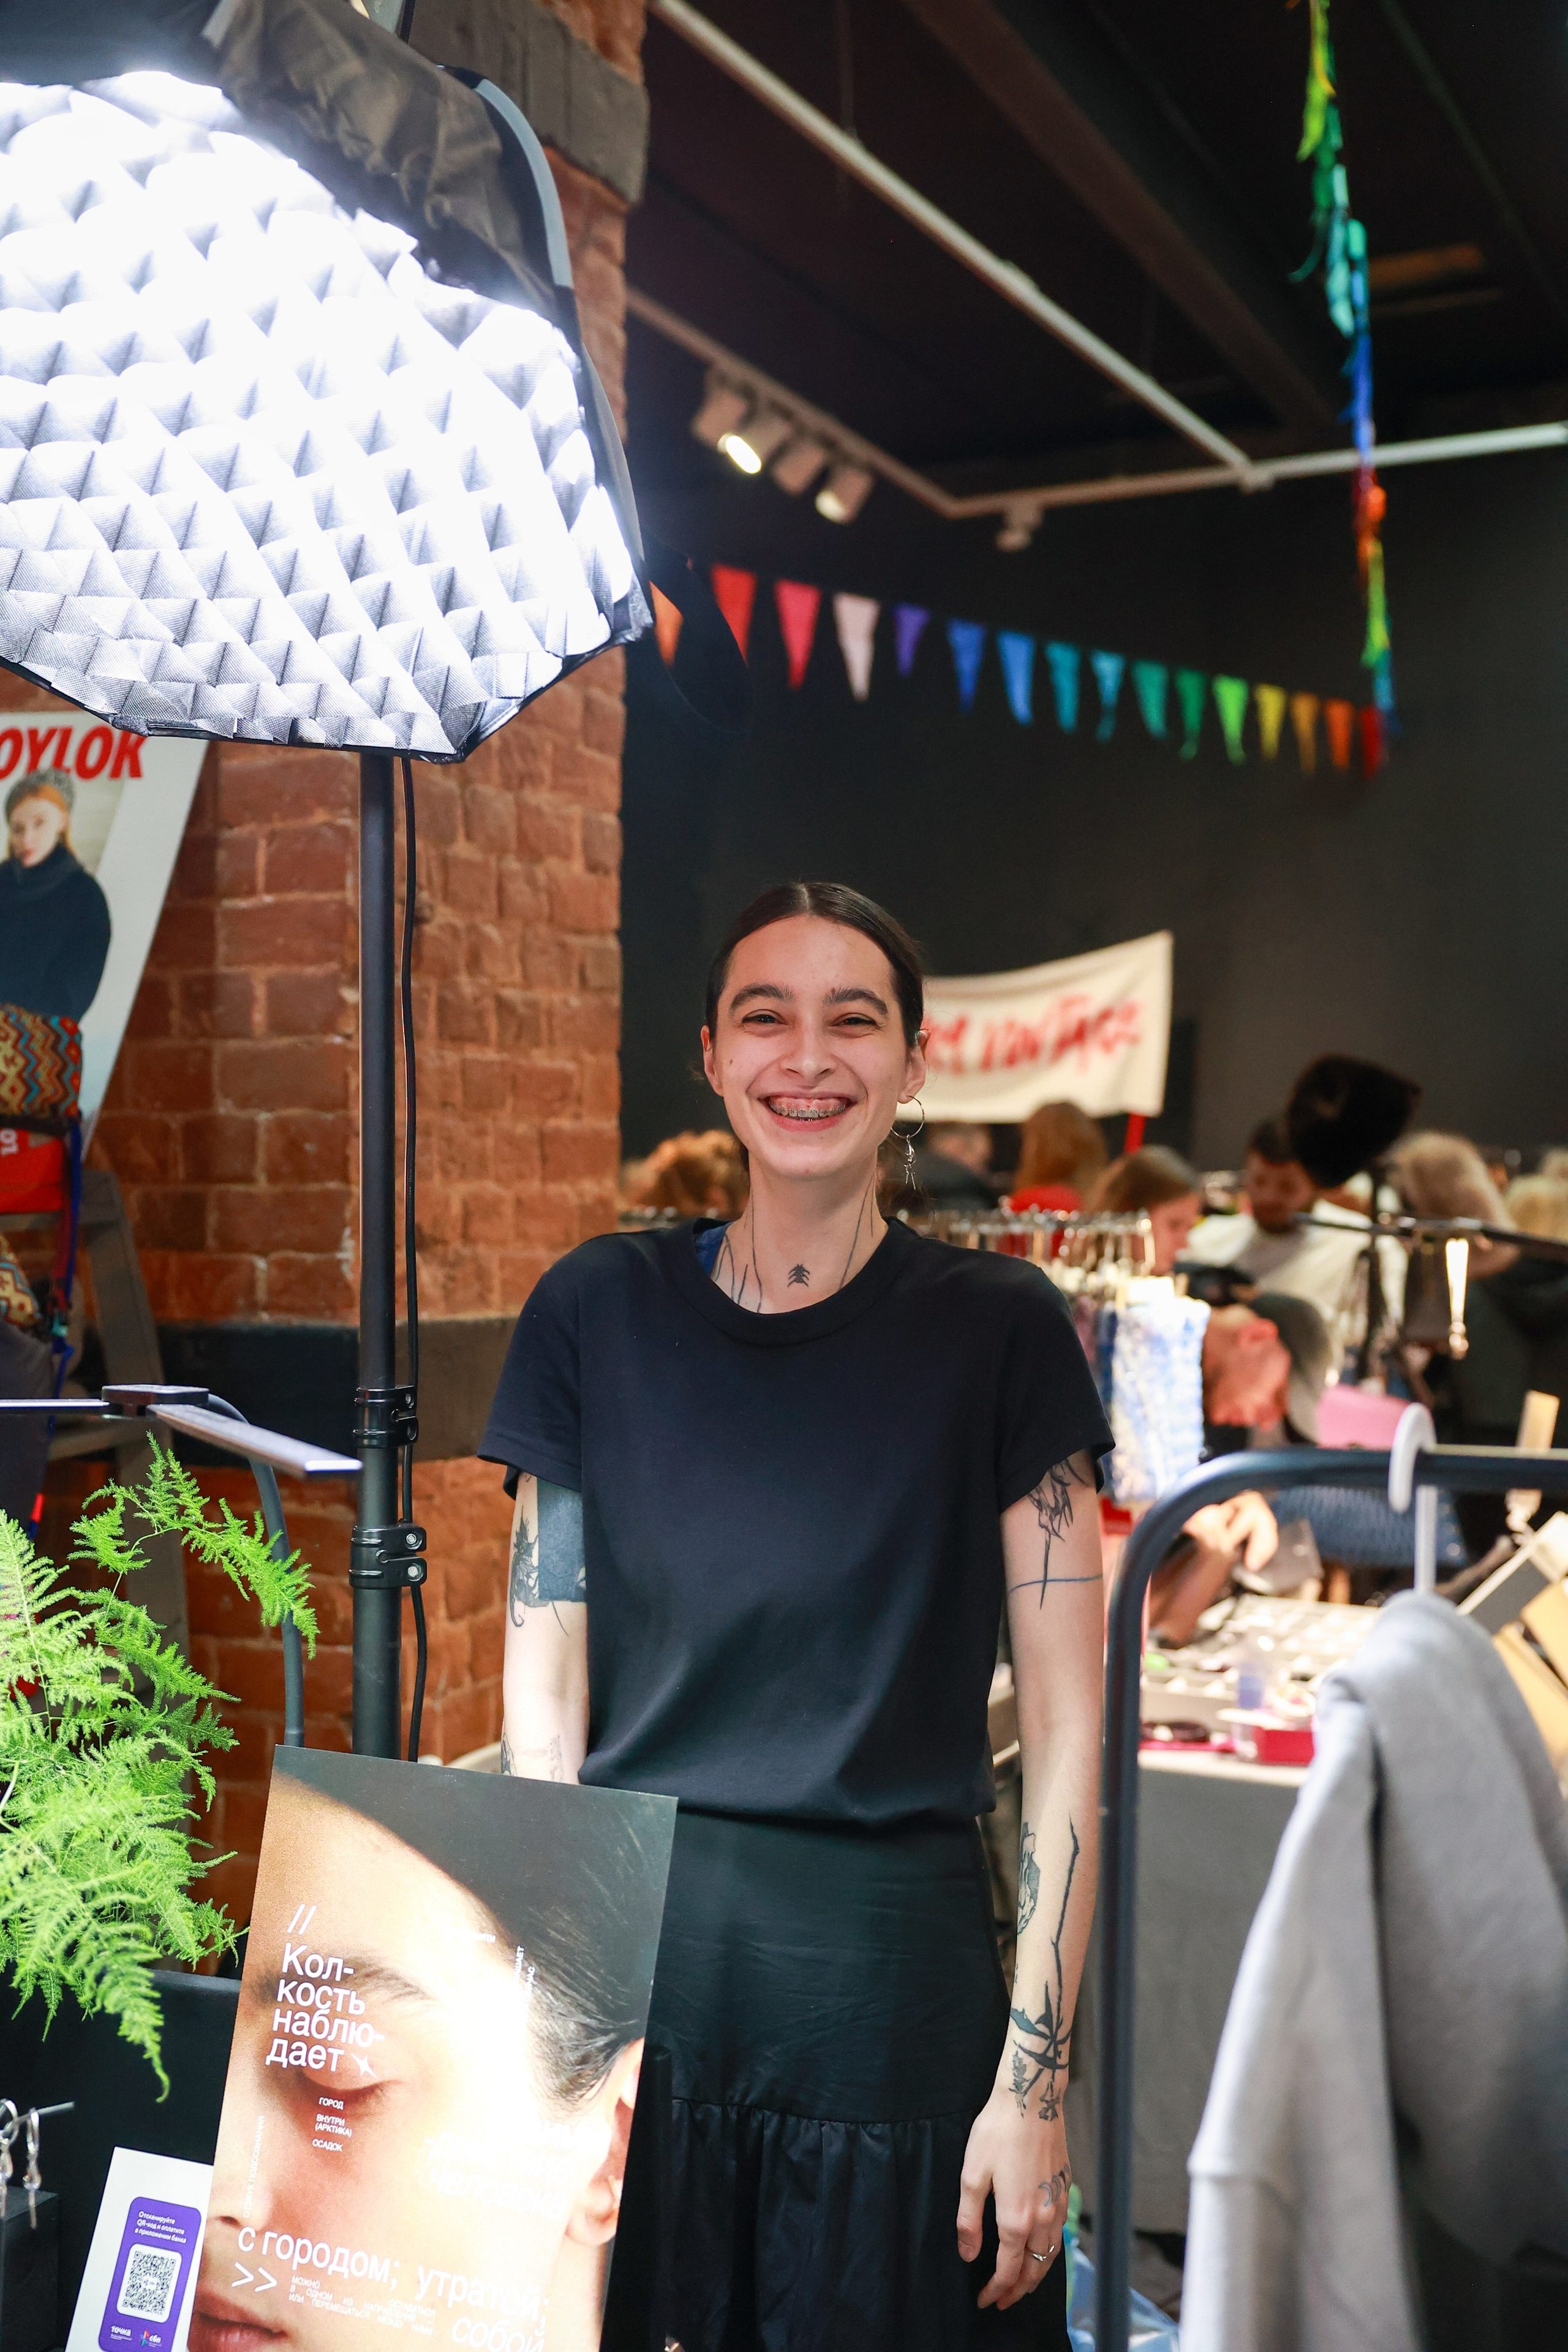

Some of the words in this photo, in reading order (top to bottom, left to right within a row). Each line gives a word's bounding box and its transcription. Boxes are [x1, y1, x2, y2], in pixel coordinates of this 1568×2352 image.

[282, 1942, 354, 1981] Кол-
[277, 1979, 366, 2015] кость
[273, 2008, 385, 2047] наблю-
[265, 2038, 345, 2072] дает
[318, 2097, 344, 2110] ГОРОД
[316, 2114, 345, 2126] ВНУТРИ
[315, 2122, 352, 2138] (АРКТИКА)
[249, 2115, 265, 2182] ПОДСОЗНАНИЯ
[312, 2139, 342, 2152] ОСАДОК
[137, 2218, 157, 2230] QR-код
[160, 2225, 185, 2235] оплатите
[138, 2211, 176, 2225] Отсканируйте
[138, 2228, 172, 2240] приложении
[171, 2234, 187, 2244] банка
[262, 2230, 400, 2290] городом;
[415, 2266, 549, 2325] утратой;
[292, 2275, 320, 2290] МОЖНО
[288, 2293, 304, 2304] ИЛИ
[290, 2284, 296, 2293] В
[306, 2288, 333, 2301] ОДНОМ
[344, 2296, 353, 2307] ИЗ
[452, 2316, 545, 2352] собой
